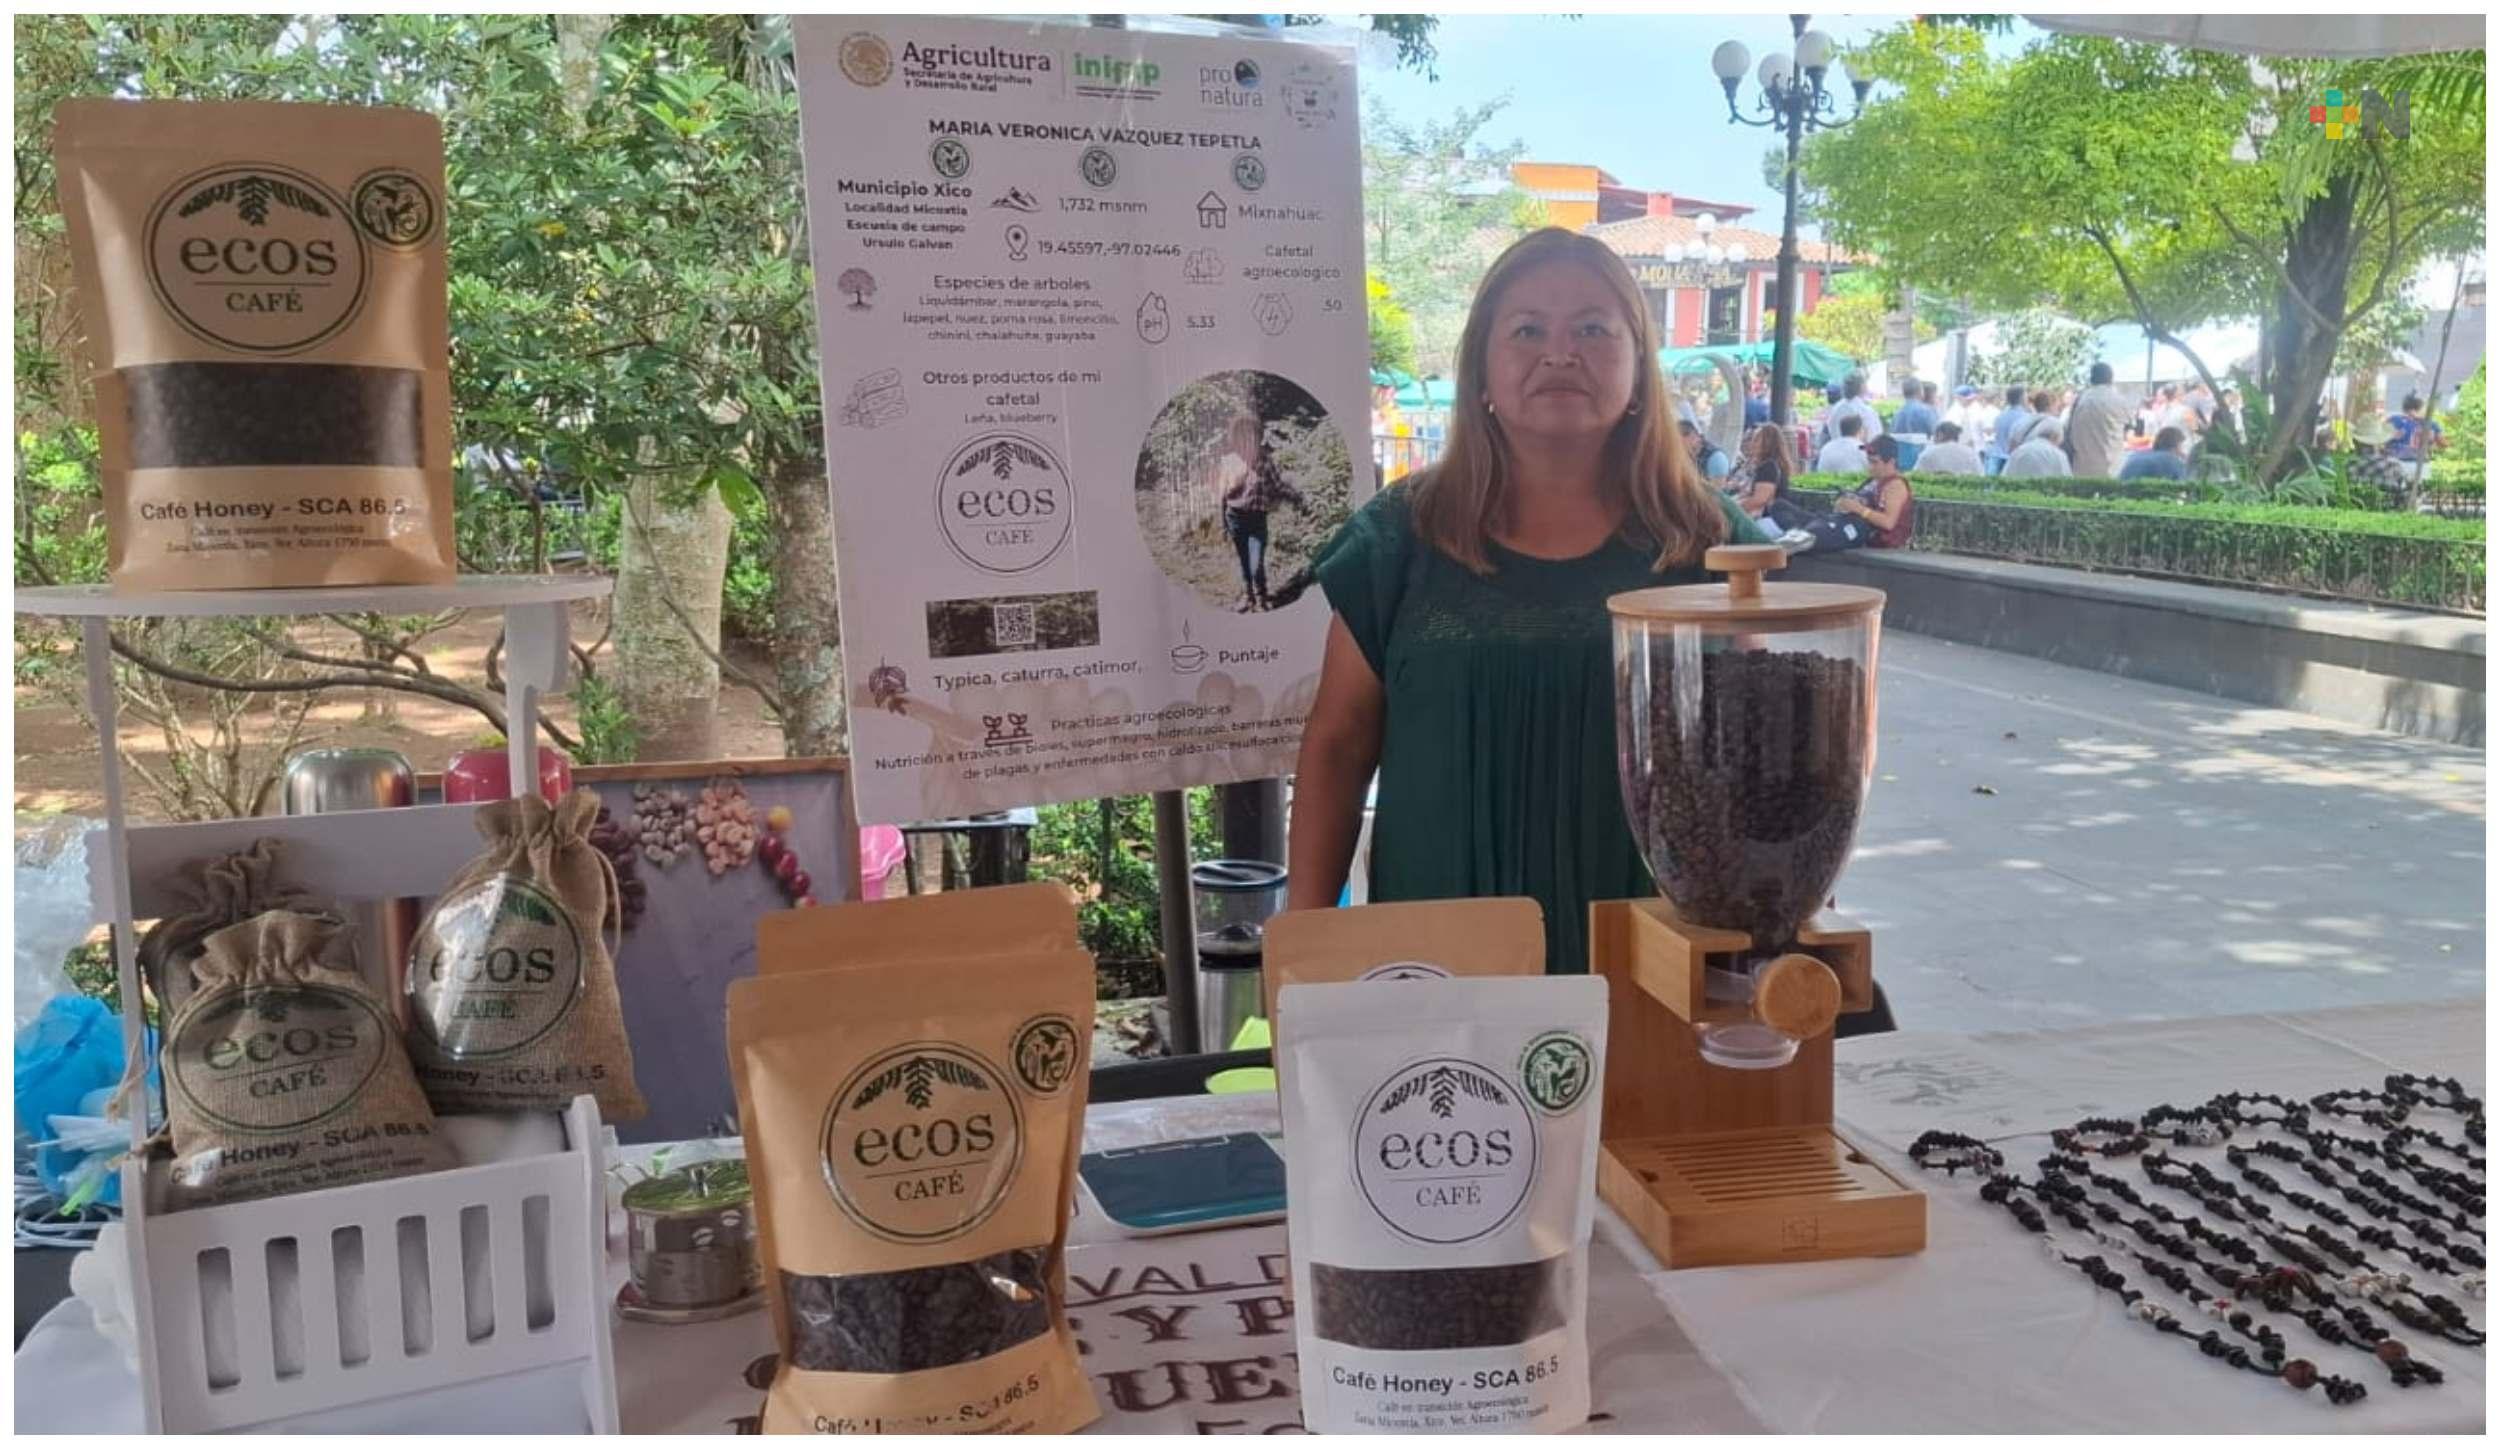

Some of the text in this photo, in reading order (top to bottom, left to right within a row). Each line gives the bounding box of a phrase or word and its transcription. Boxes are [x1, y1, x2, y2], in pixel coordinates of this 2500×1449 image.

[902, 41, 1051, 71] Agricultura
[1199, 65, 1231, 86] pro
[1200, 86, 1263, 107] natura
[929, 119, 1262, 149] MARIA VERONICA VAZQUEZ TEPETLA
[838, 180, 972, 199] Municipio Xico
[845, 202, 910, 214] Localidad
[1060, 198, 1148, 213] 1,732 msnm
[901, 222, 918, 232] de
[922, 224, 966, 235] campo
[863, 238, 905, 249] Ursulo
[1265, 244, 1314, 259] Cafetal
[180, 237, 337, 276] ecos
[934, 275, 1091, 291] Especies de arboles
[225, 288, 303, 313] CAFÉ
[1186, 315, 1216, 329] 5.33
[923, 371, 1101, 388] Otros productos de mi
[986, 392, 1040, 406] cafetal
[140, 502, 188, 520] Café
[194, 501, 275, 519] Honey
[300, 499, 352, 515] SCA
[359, 498, 407, 516] 86.5
[956, 489, 1056, 519] ecos
[1219, 648, 1280, 666] Puntaje
[934, 674, 997, 692] Typica,
[1001, 667, 1069, 684] caturra,
[1051, 713, 1120, 732] Practicas
[876, 754, 943, 770] Nutrición
[963, 767, 983, 781] de
[203, 1025, 358, 1070] ecos
[249, 1067, 328, 1098] CAFÉ
[221, 1141, 300, 1168] Honey
[323, 1127, 377, 1148] SCA
[854, 1114, 995, 1167] ecos
[1380, 1128, 1513, 1170] ecos
[895, 1169, 965, 1202] CAFÉ
[1416, 1181, 1482, 1208] CAFÉ
[1332, 1365, 1377, 1391] Café
[1383, 1374, 1454, 1396] Honey
[1473, 1368, 1521, 1390] SCA
[1525, 1354, 1559, 1384] 86.5
